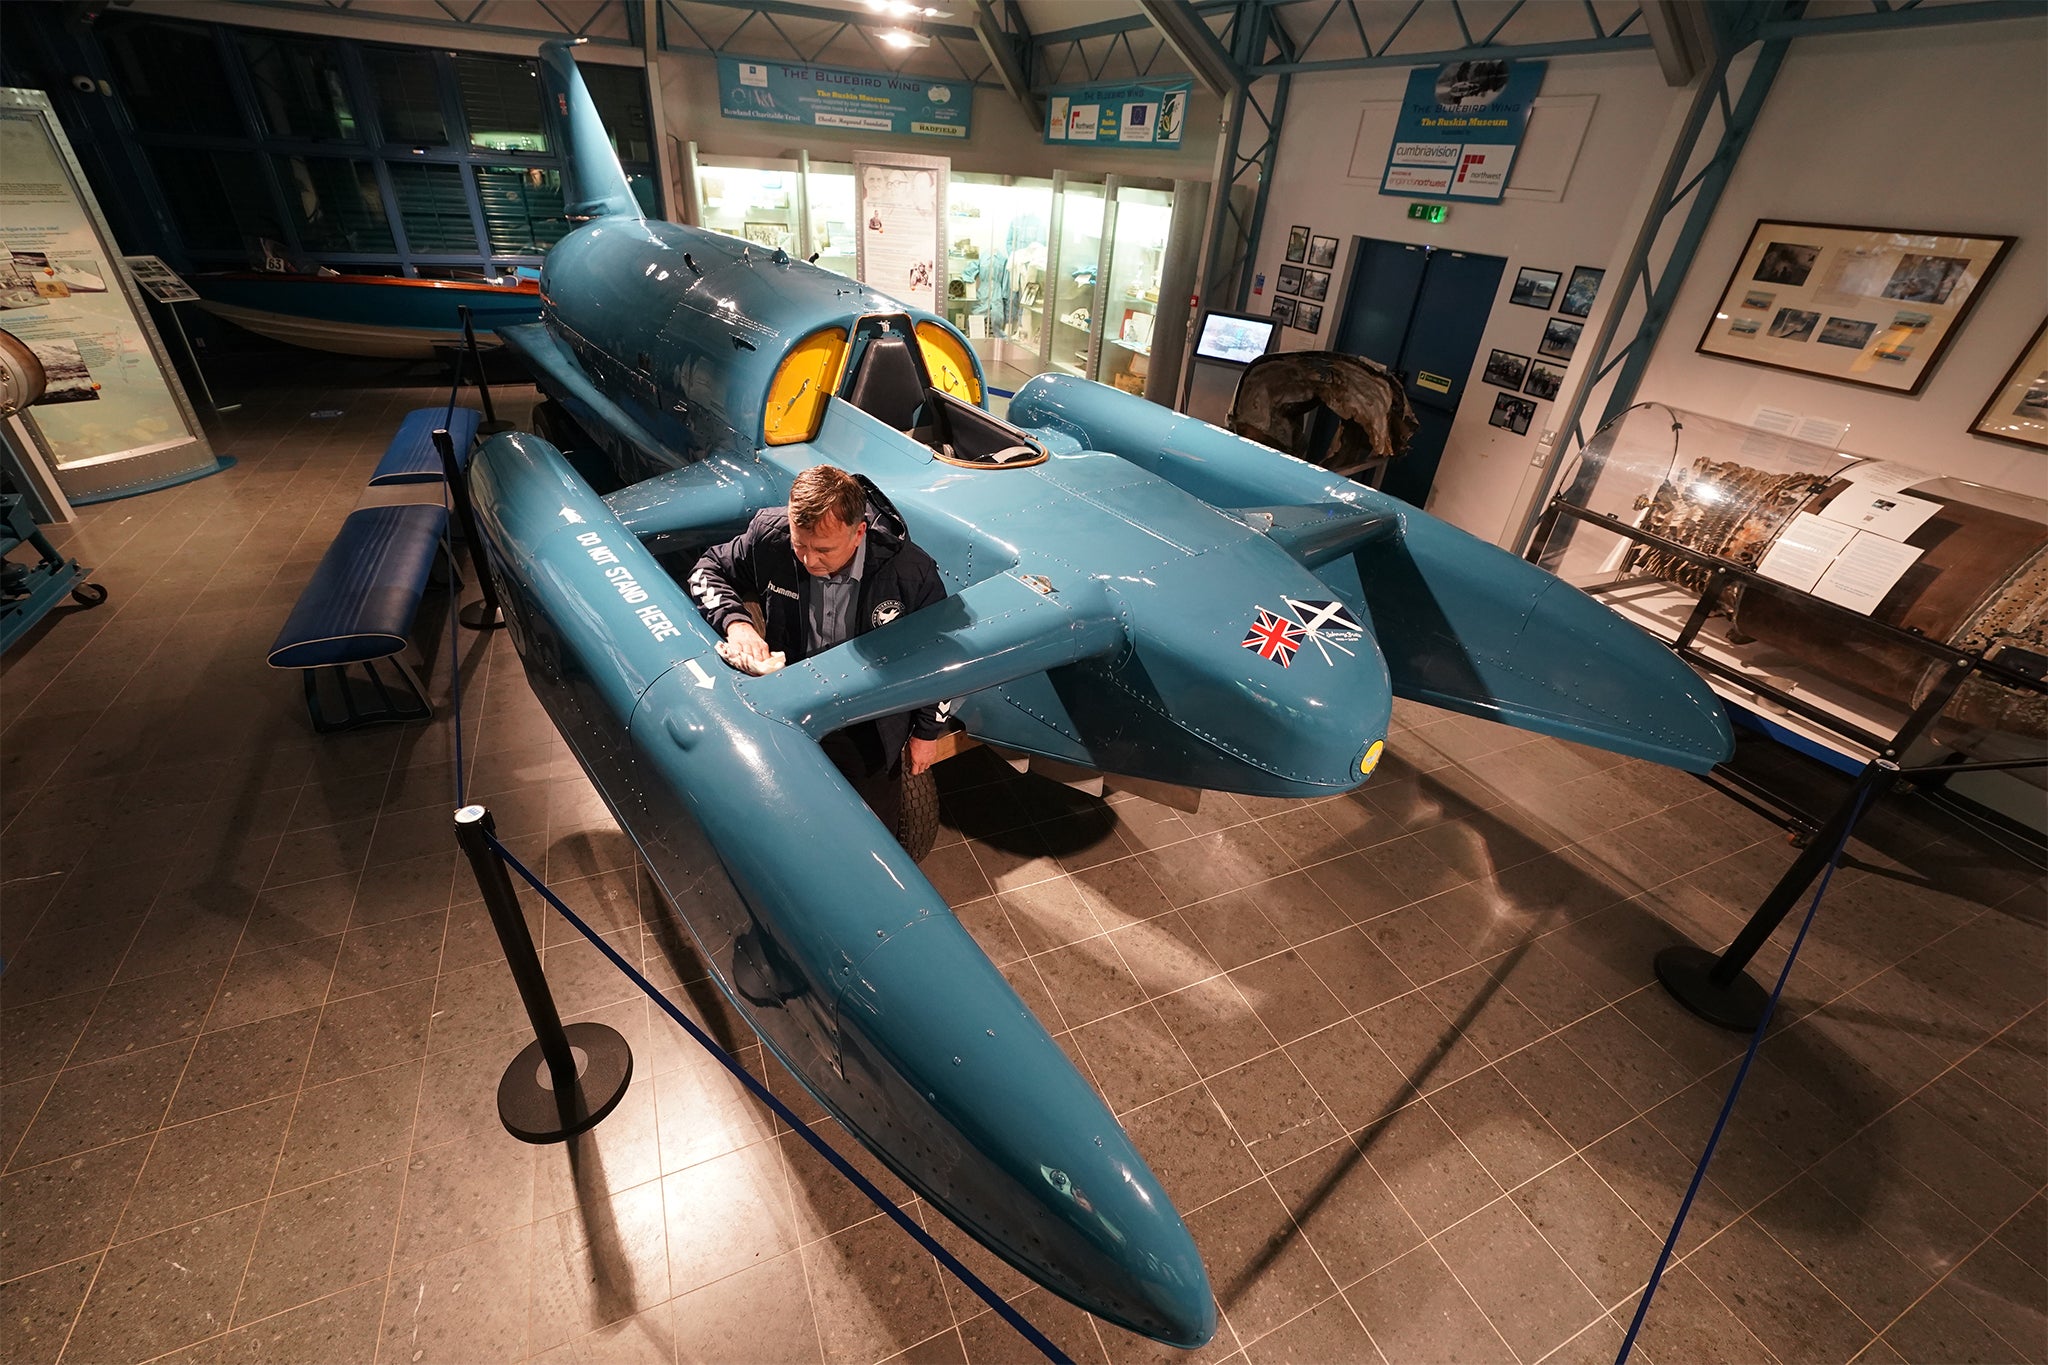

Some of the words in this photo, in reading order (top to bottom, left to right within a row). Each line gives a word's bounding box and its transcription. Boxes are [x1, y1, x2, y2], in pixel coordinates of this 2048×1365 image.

[781, 67, 808, 80] THE
[815, 71, 882, 88] BLUEBIRD
[887, 79, 920, 92] WING
[1435, 103, 1486, 113] BLUEBIRD
[1491, 103, 1521, 112] WING
[1421, 118, 1435, 126] The
[1437, 118, 1467, 127] Ruskin
[1468, 117, 1508, 126] Museum
[1396, 144, 1458, 158] cumbriavision
[269, 257, 281, 270] 63
[576, 531, 602, 547] DO
[587, 545, 620, 566] NOT
[605, 566, 649, 604] STAND
[767, 580, 800, 600] hummel
[635, 605, 681, 643] HERE
